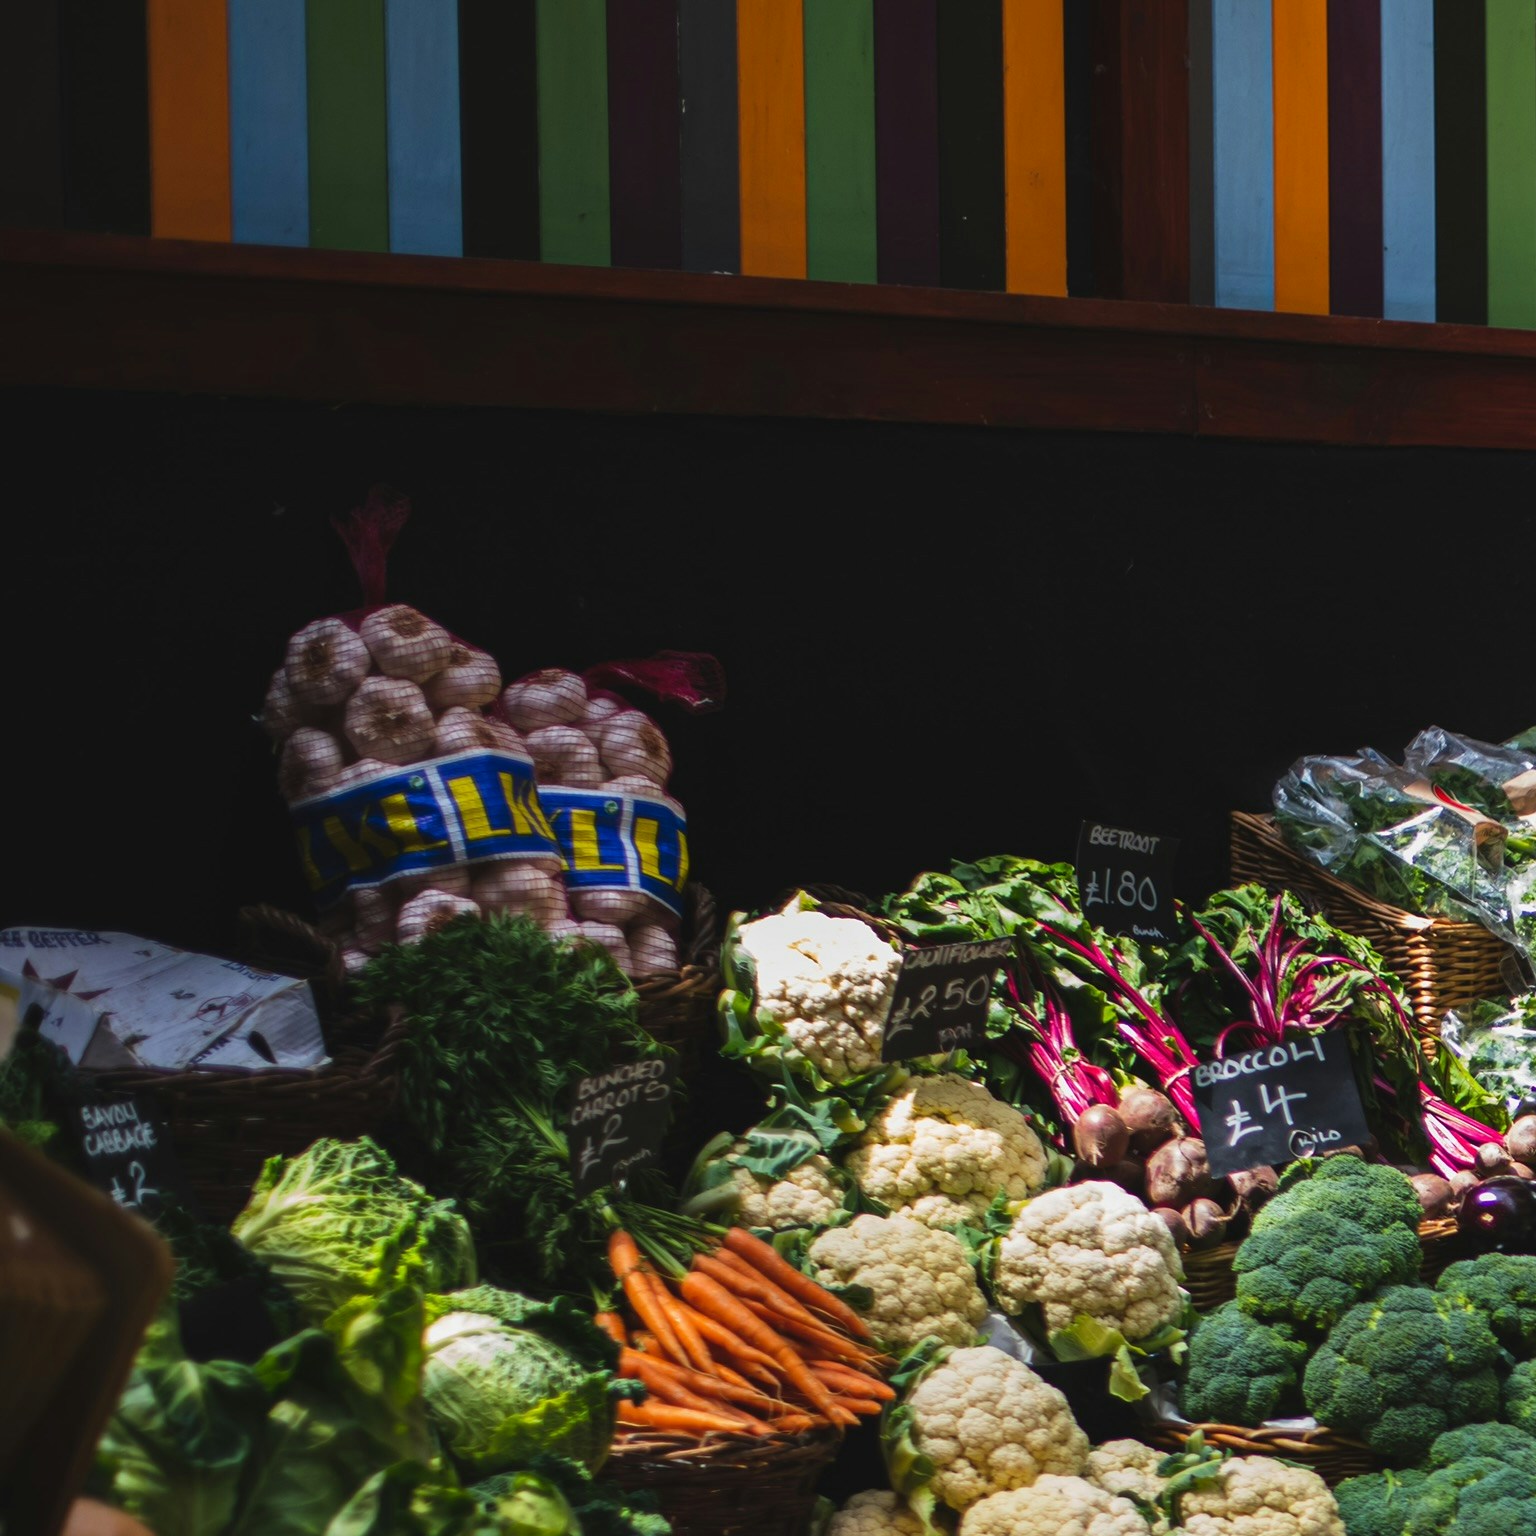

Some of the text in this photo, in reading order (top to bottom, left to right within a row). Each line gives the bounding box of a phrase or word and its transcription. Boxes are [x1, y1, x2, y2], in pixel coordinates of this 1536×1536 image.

[1089, 825, 1160, 855] BEETROOT
[1086, 868, 1157, 911] £1.80
[886, 973, 990, 1041] £2.50
[1194, 1036, 1326, 1088] BROCCOLI
[571, 1080, 671, 1126] CARROTS
